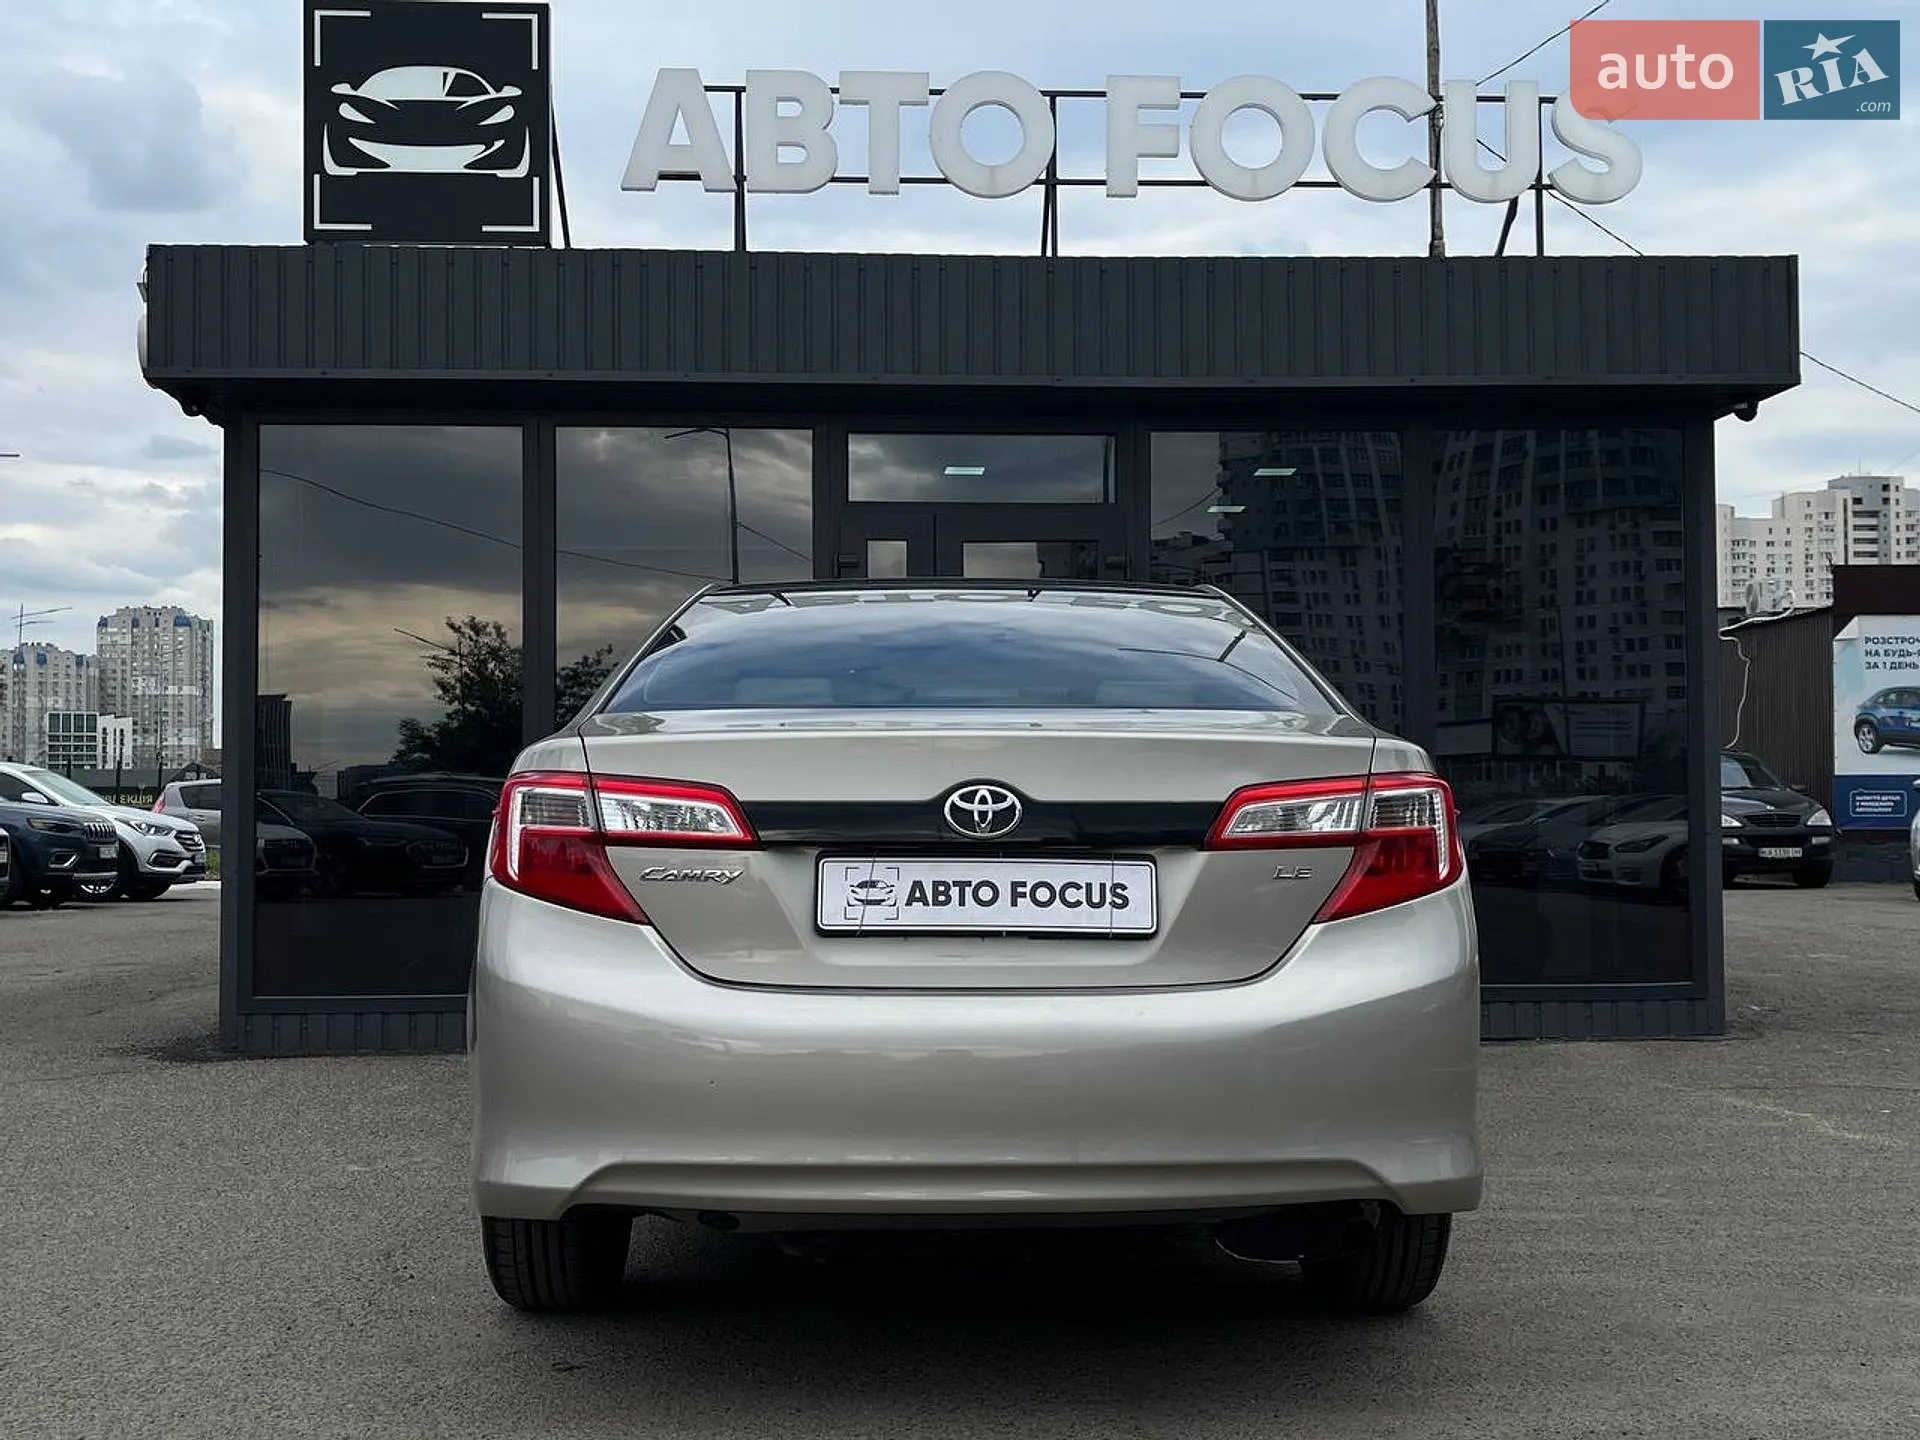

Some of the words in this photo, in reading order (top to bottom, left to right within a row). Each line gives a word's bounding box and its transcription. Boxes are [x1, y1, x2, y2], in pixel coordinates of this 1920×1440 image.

[621, 67, 1056, 200] АВТО
[1105, 74, 1642, 205] FOCUS
[1864, 648, 1881, 657] НА
[1865, 661, 1879, 670] ЗА
[1889, 661, 1920, 671] ДЕНЬ
[640, 866, 744, 885] CAMRY
[1272, 865, 1313, 881] LE
[904, 879, 1000, 908] АВТО
[1009, 881, 1130, 910] FOCUS
